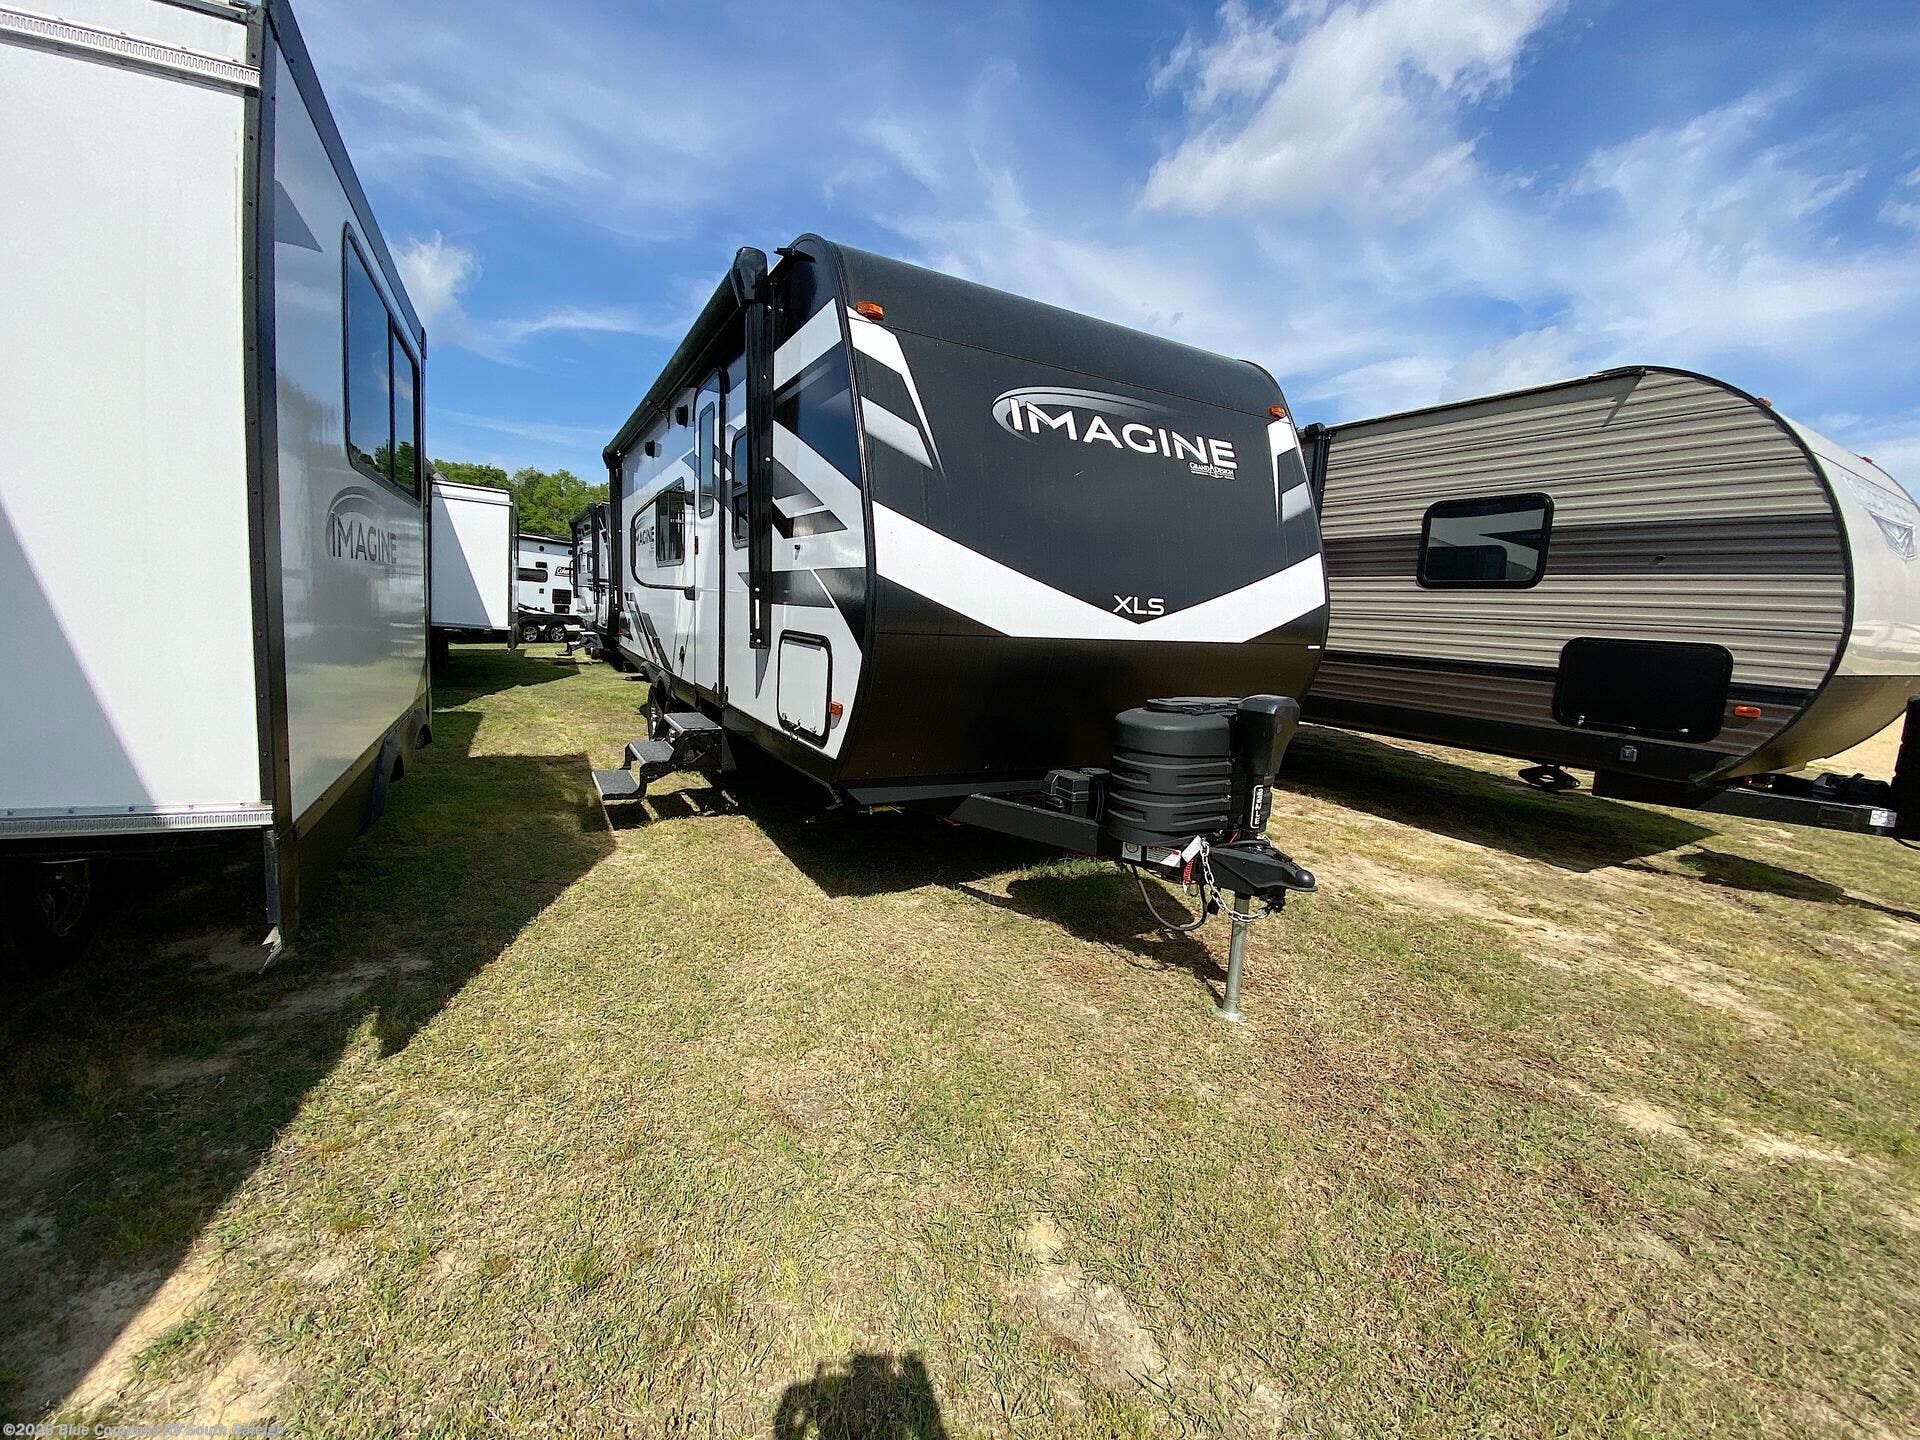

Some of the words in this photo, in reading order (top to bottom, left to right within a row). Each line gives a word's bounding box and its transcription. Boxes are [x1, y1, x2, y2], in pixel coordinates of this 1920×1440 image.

[1009, 397, 1238, 469] IMAGINE
[331, 512, 397, 564] IMAGINE
[1112, 594, 1165, 616] XLS
